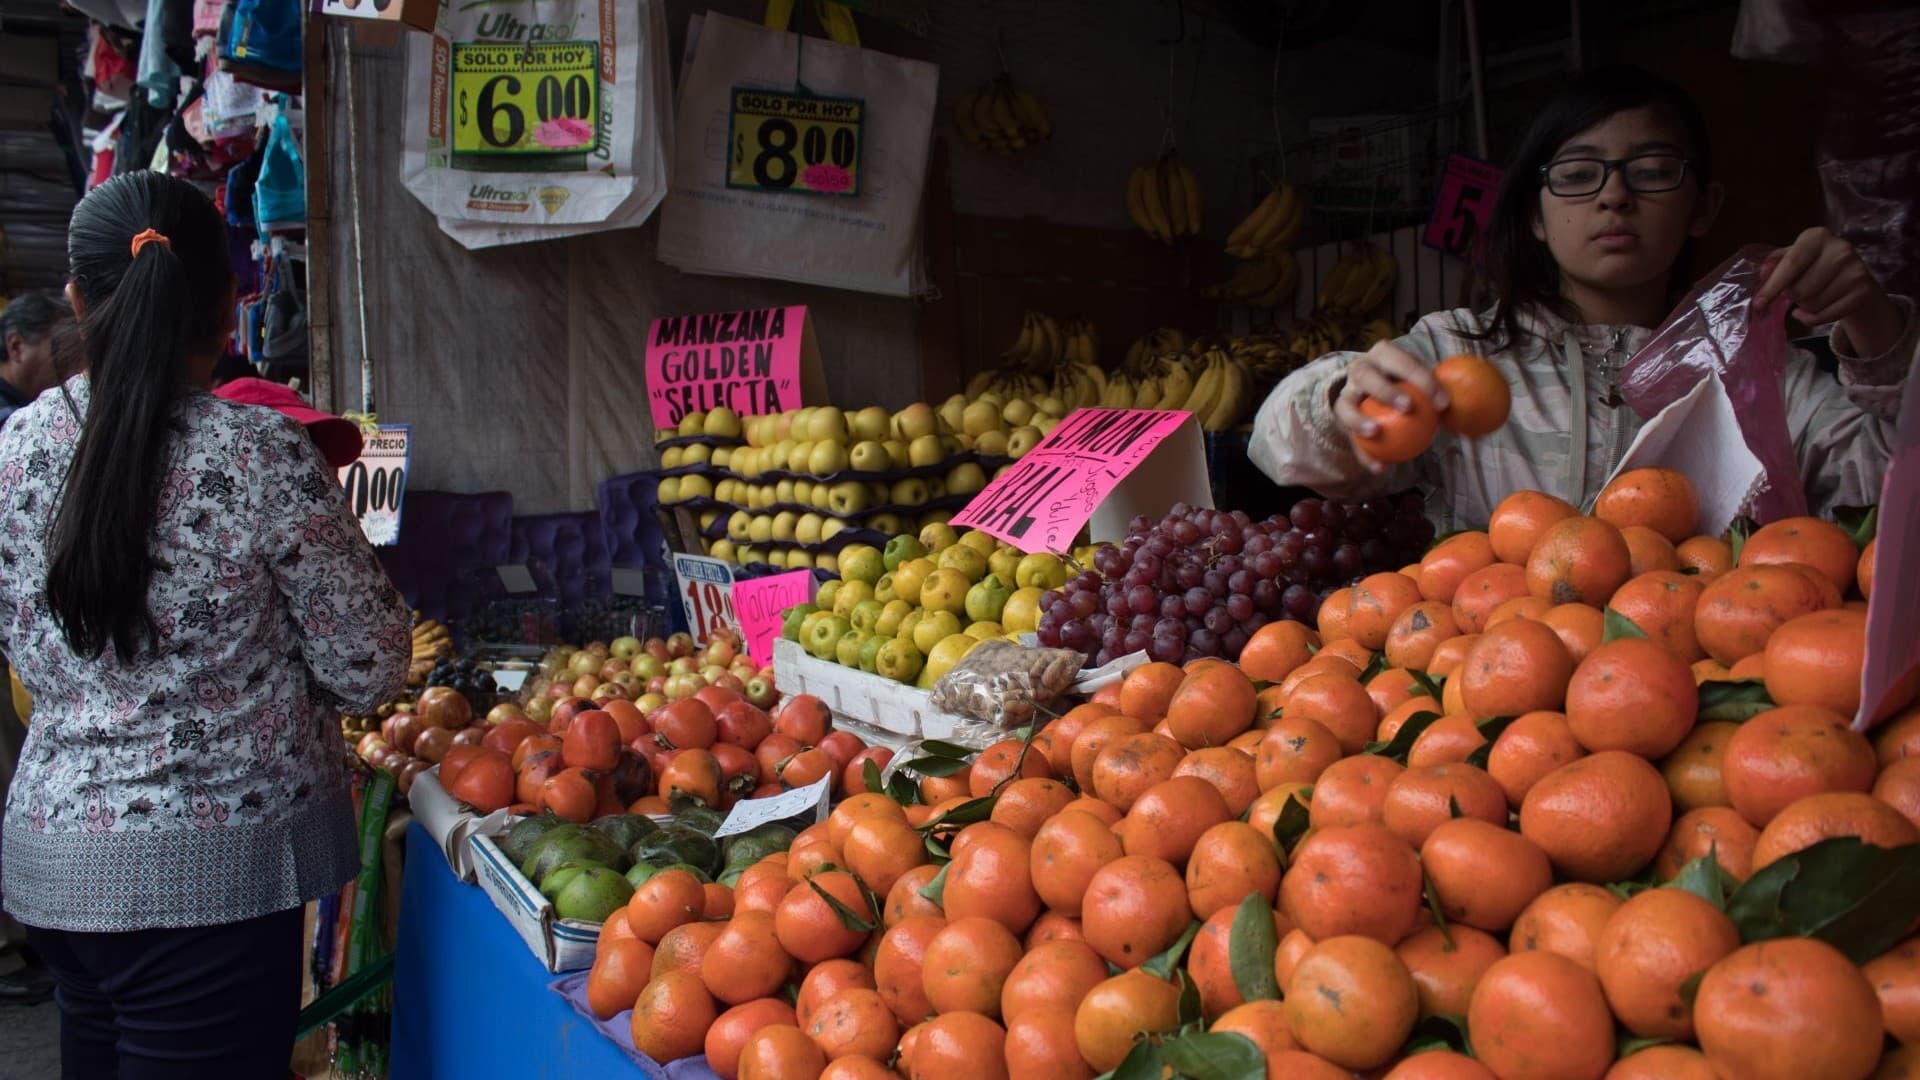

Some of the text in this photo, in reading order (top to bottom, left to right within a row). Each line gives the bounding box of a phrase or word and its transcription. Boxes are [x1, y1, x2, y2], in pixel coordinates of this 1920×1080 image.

[477, 12, 580, 41] Ultrasol
[434, 44, 449, 73] SOP
[463, 50, 586, 66] SOLO POR HOY
[741, 96, 855, 118] SOLO POR HOY
[469, 184, 531, 201] Ultrasol
[656, 308, 784, 347] MANZANA
[661, 342, 774, 384] GOLDEN
[369, 438, 406, 450] PRECIO
[963, 462, 1077, 539] REAL
[1046, 500, 1071, 548] dulce
